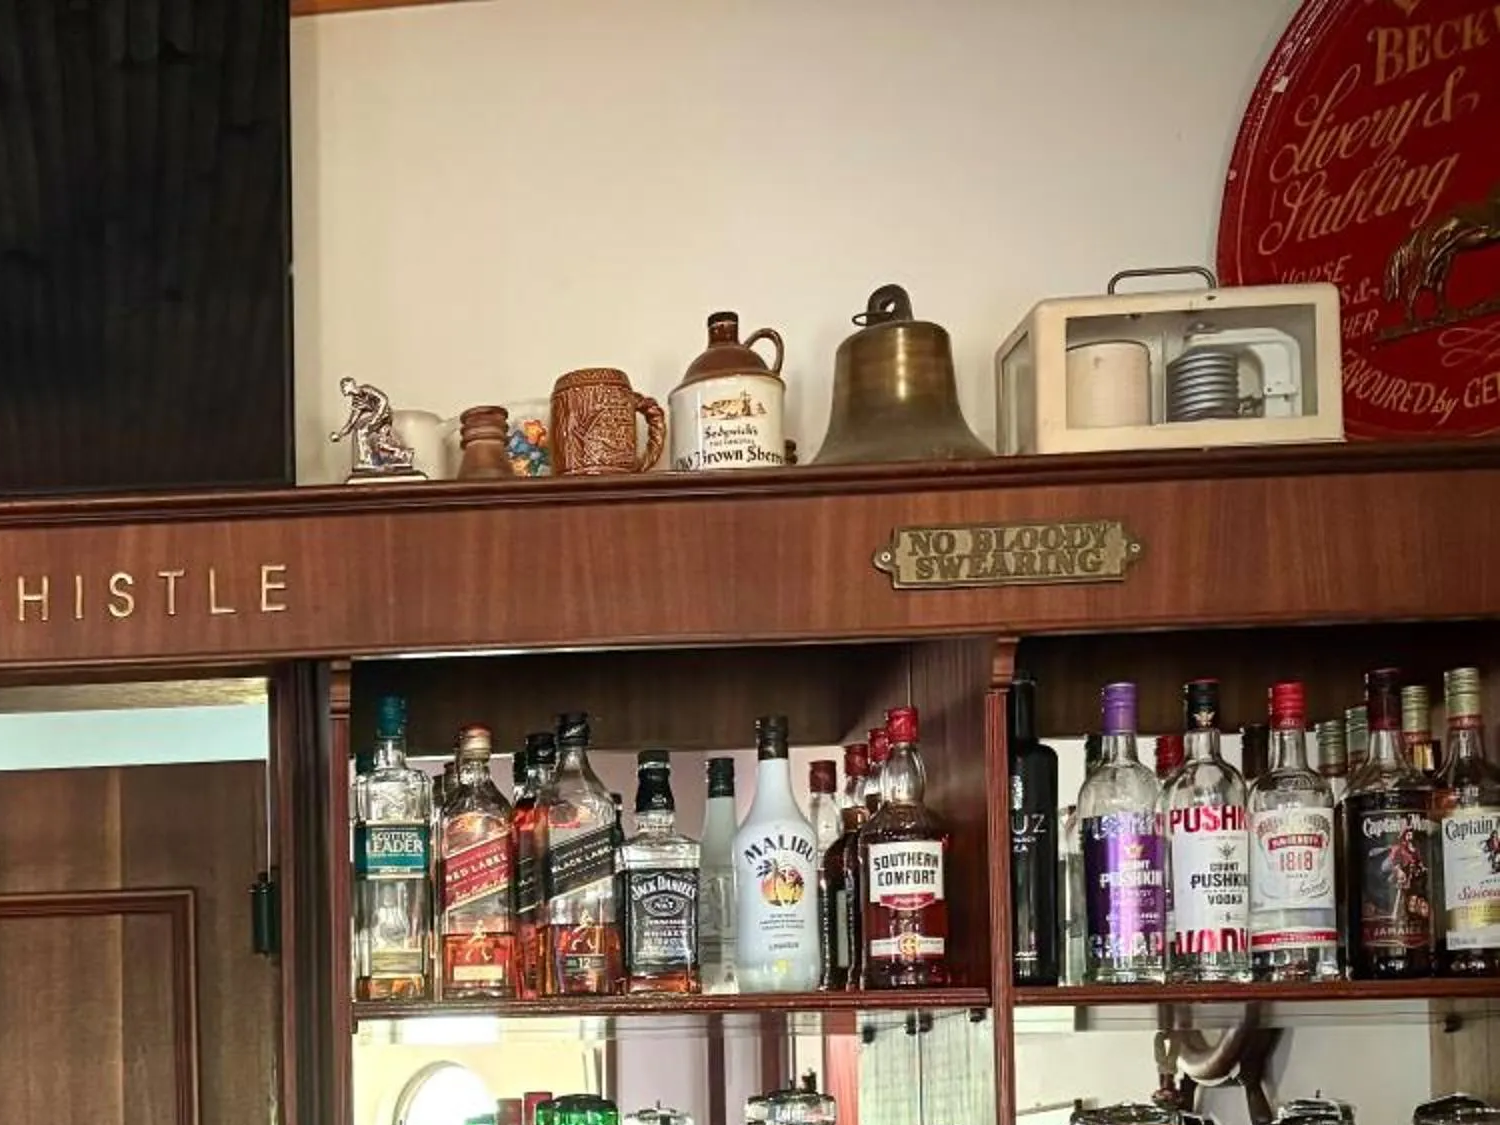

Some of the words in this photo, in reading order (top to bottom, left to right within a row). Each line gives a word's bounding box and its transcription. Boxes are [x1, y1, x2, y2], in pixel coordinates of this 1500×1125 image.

[1270, 64, 1425, 182] Livery
[1258, 152, 1459, 255] Stabling
[1342, 352, 1434, 413] AVOURED
[1432, 393, 1460, 425] by
[695, 448, 743, 466] Brown
[908, 532, 956, 556] NO
[972, 524, 1107, 552] BLOODY
[915, 550, 1104, 580] SWEARING
[371, 831, 419, 841] SCOTTISH
[1445, 816, 1493, 841] Captain
[744, 834, 814, 864] MALIBU
[470, 852, 508, 871] LABEL
[873, 852, 939, 871] SOUTHERN
[1280, 850, 1313, 872] 1818
[877, 869, 936, 887] COMFORT
[631, 881, 657, 900] JACK
